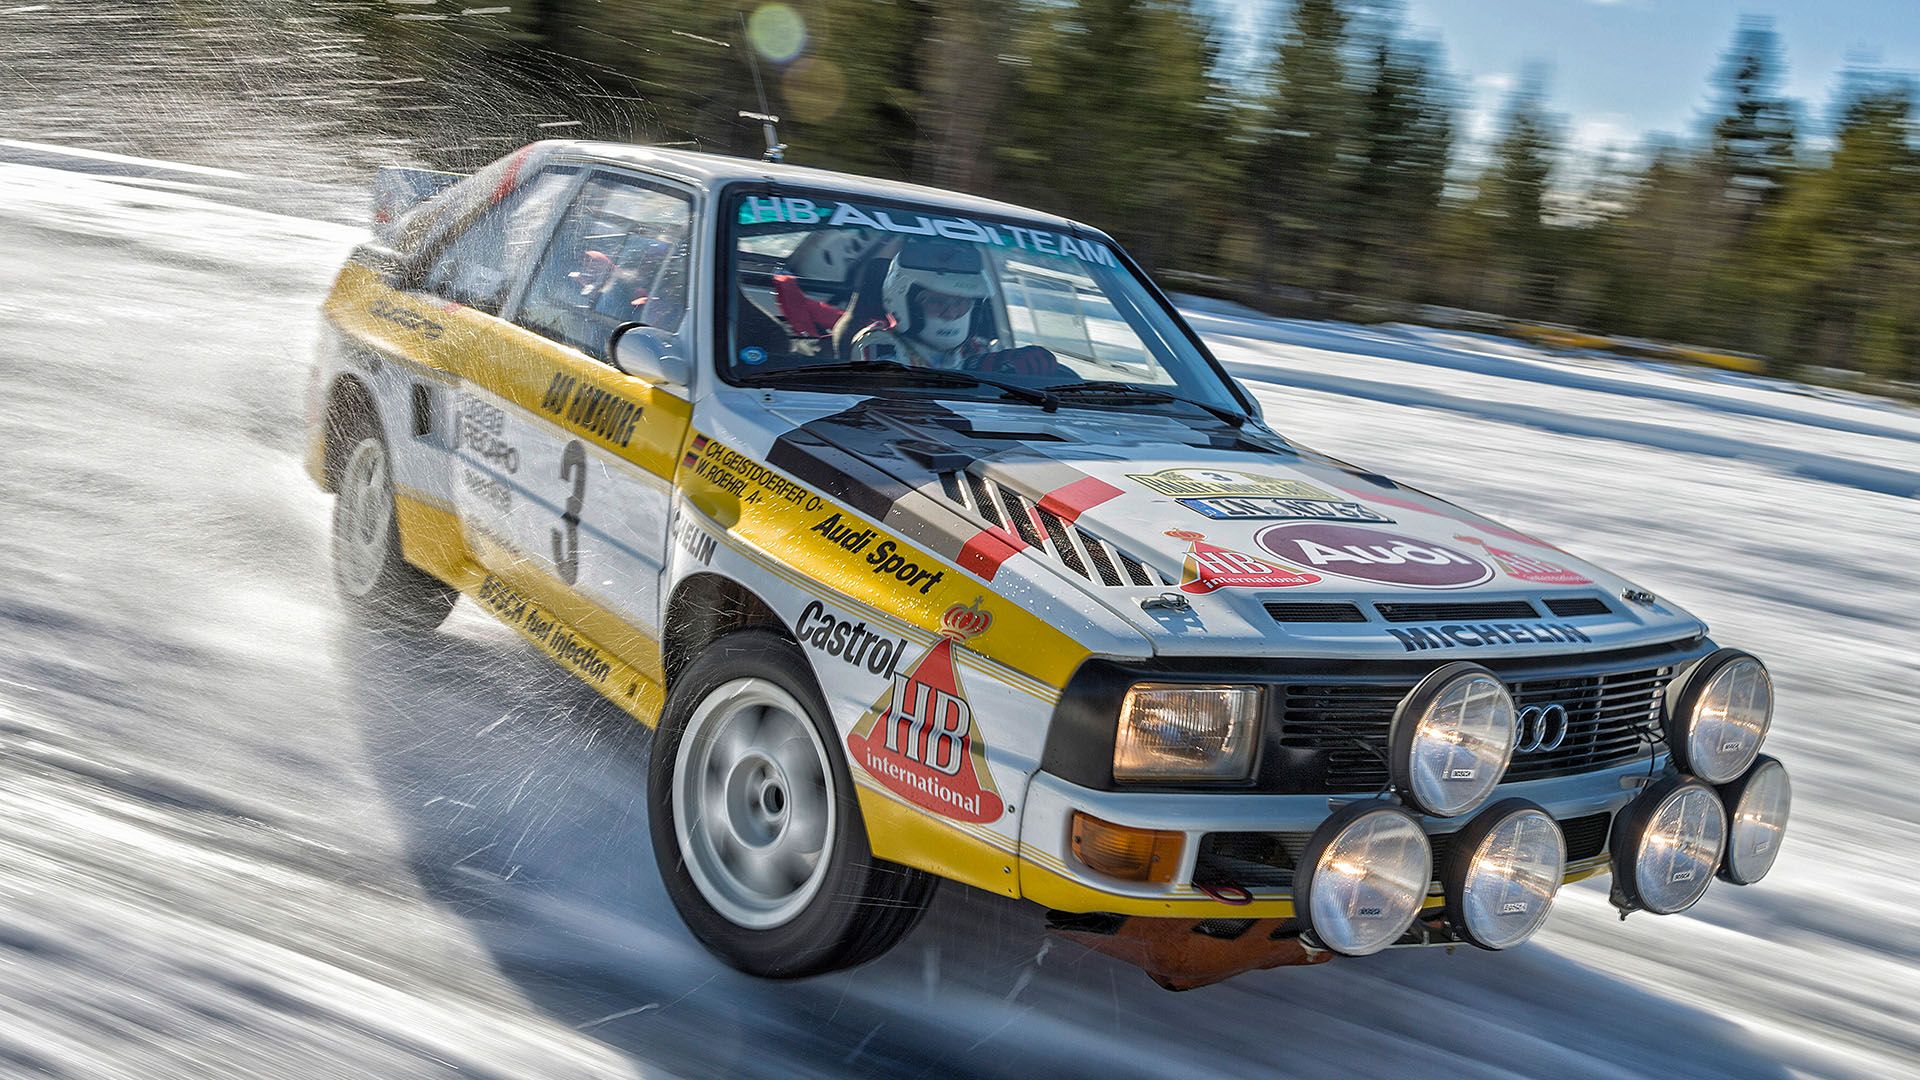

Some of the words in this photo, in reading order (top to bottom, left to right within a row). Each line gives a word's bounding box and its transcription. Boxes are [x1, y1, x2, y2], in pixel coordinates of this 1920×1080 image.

[746, 196, 821, 224] HB
[1000, 224, 1117, 268] TEAM
[552, 439, 587, 586] 3
[810, 512, 878, 555] Audi
[866, 540, 945, 596] Sport
[1182, 552, 1273, 574] HB
[1203, 575, 1309, 589] international
[522, 608, 554, 642] fuel
[549, 623, 612, 683] injection
[795, 599, 909, 681] Castrol
[1385, 623, 1592, 652] MICHELIN
[884, 671, 971, 776] HB
[866, 748, 981, 816] international
